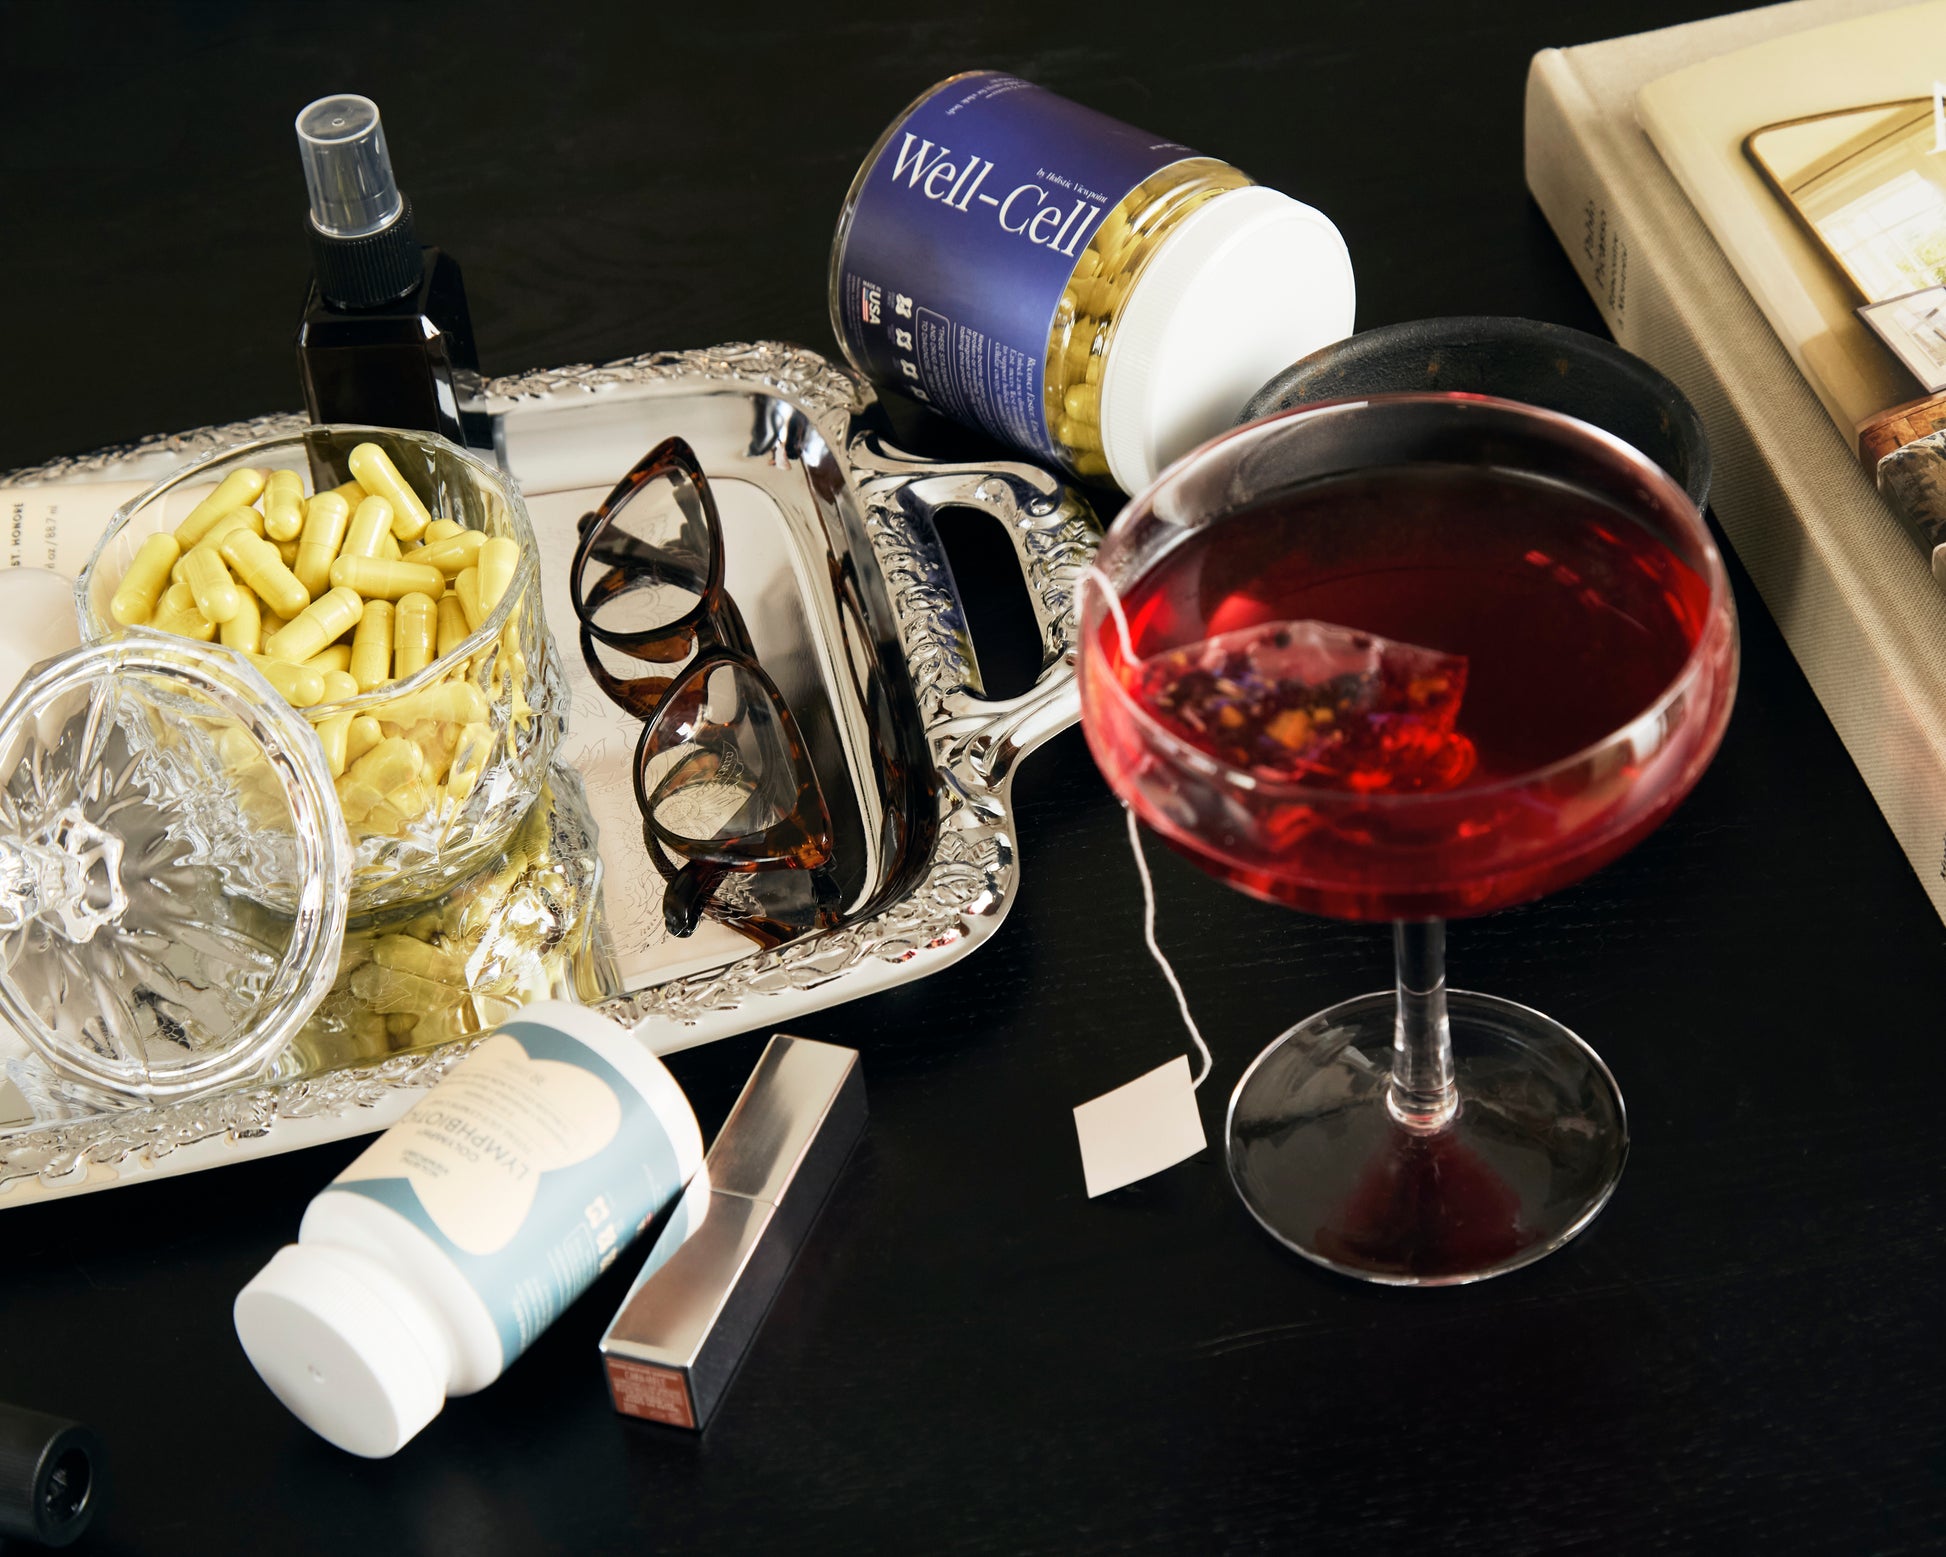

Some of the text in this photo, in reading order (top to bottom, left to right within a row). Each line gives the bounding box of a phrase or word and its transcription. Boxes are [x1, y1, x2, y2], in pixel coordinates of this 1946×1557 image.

[892, 132, 1101, 257] Well-Cell
[1046, 172, 1073, 189] Holistic
[1073, 182, 1108, 204] Viewpoint
[869, 290, 881, 325] USA
[1027, 356, 1036, 392] Recover
[10, 549, 21, 567] ST.
[47, 548, 56, 561] oz
